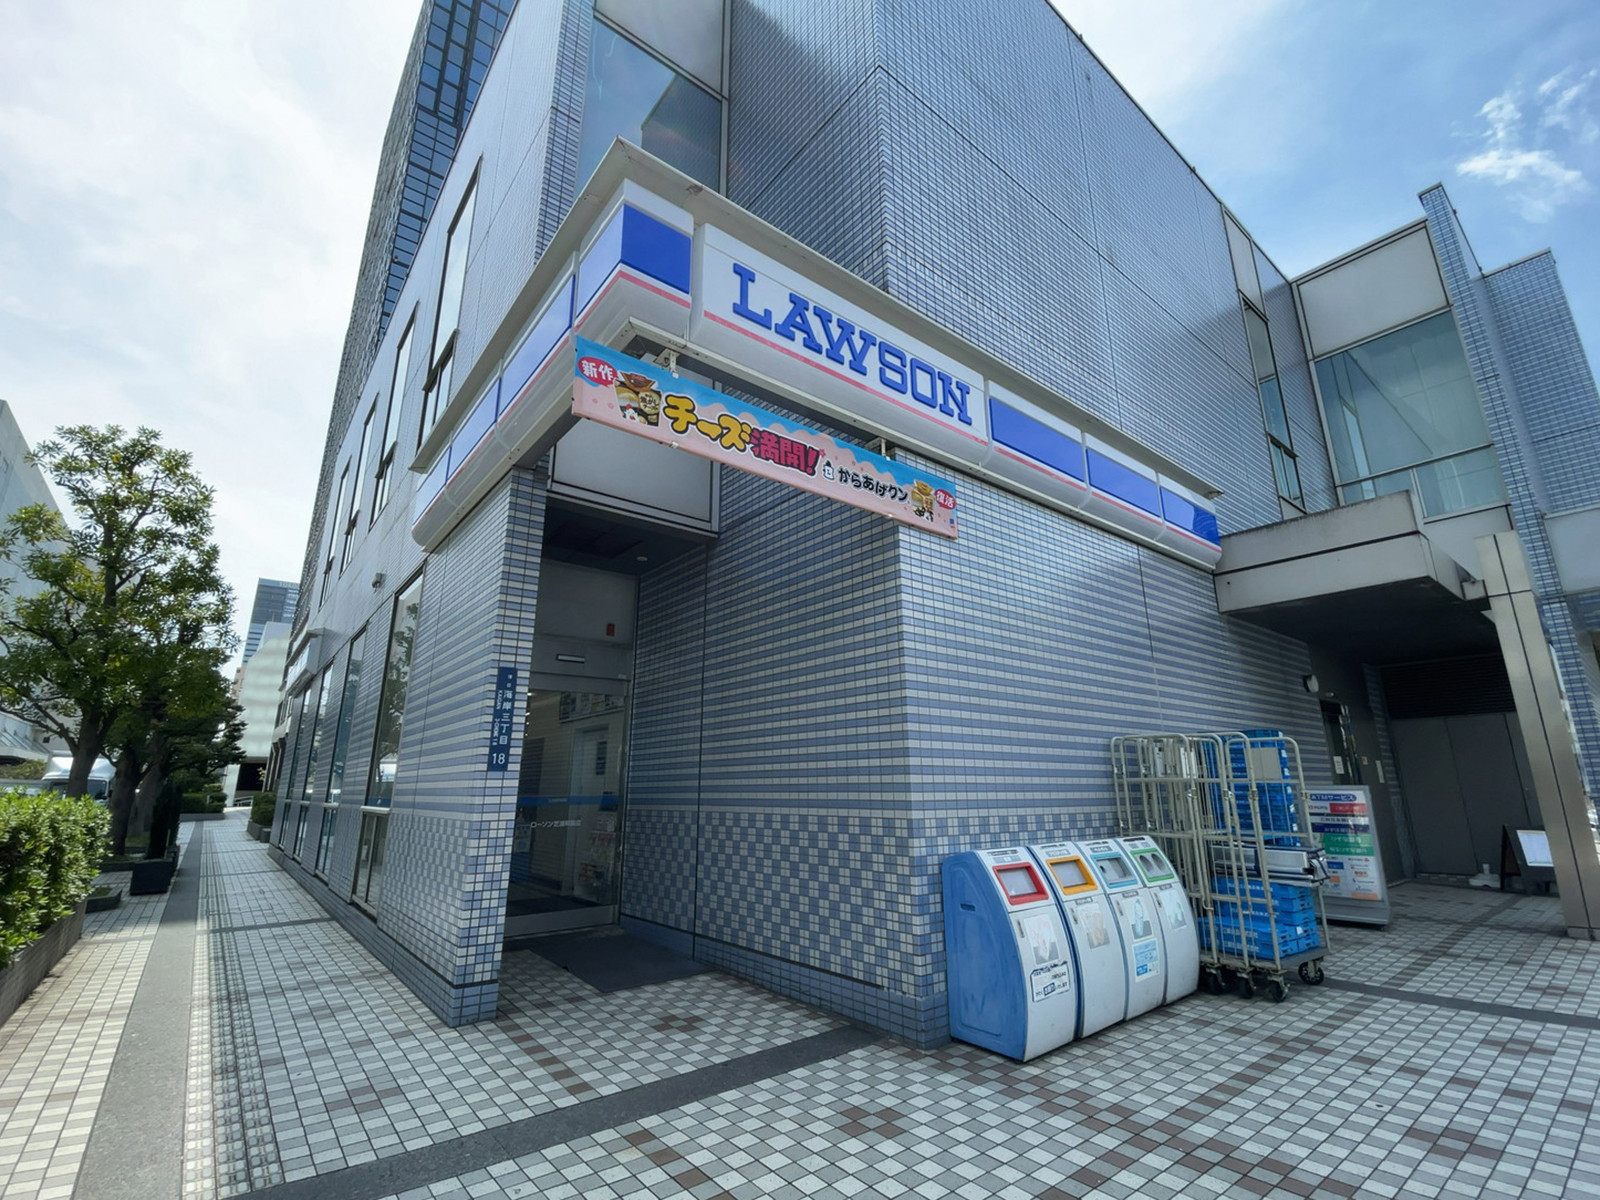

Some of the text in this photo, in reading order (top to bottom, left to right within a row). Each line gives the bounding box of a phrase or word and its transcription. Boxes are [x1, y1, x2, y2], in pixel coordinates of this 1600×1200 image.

[732, 262, 973, 426] LAWSON
[581, 360, 614, 381] 新作
[837, 467, 909, 502] からあげクン
[498, 690, 512, 745] 海岸三丁目
[492, 752, 506, 765] 18
